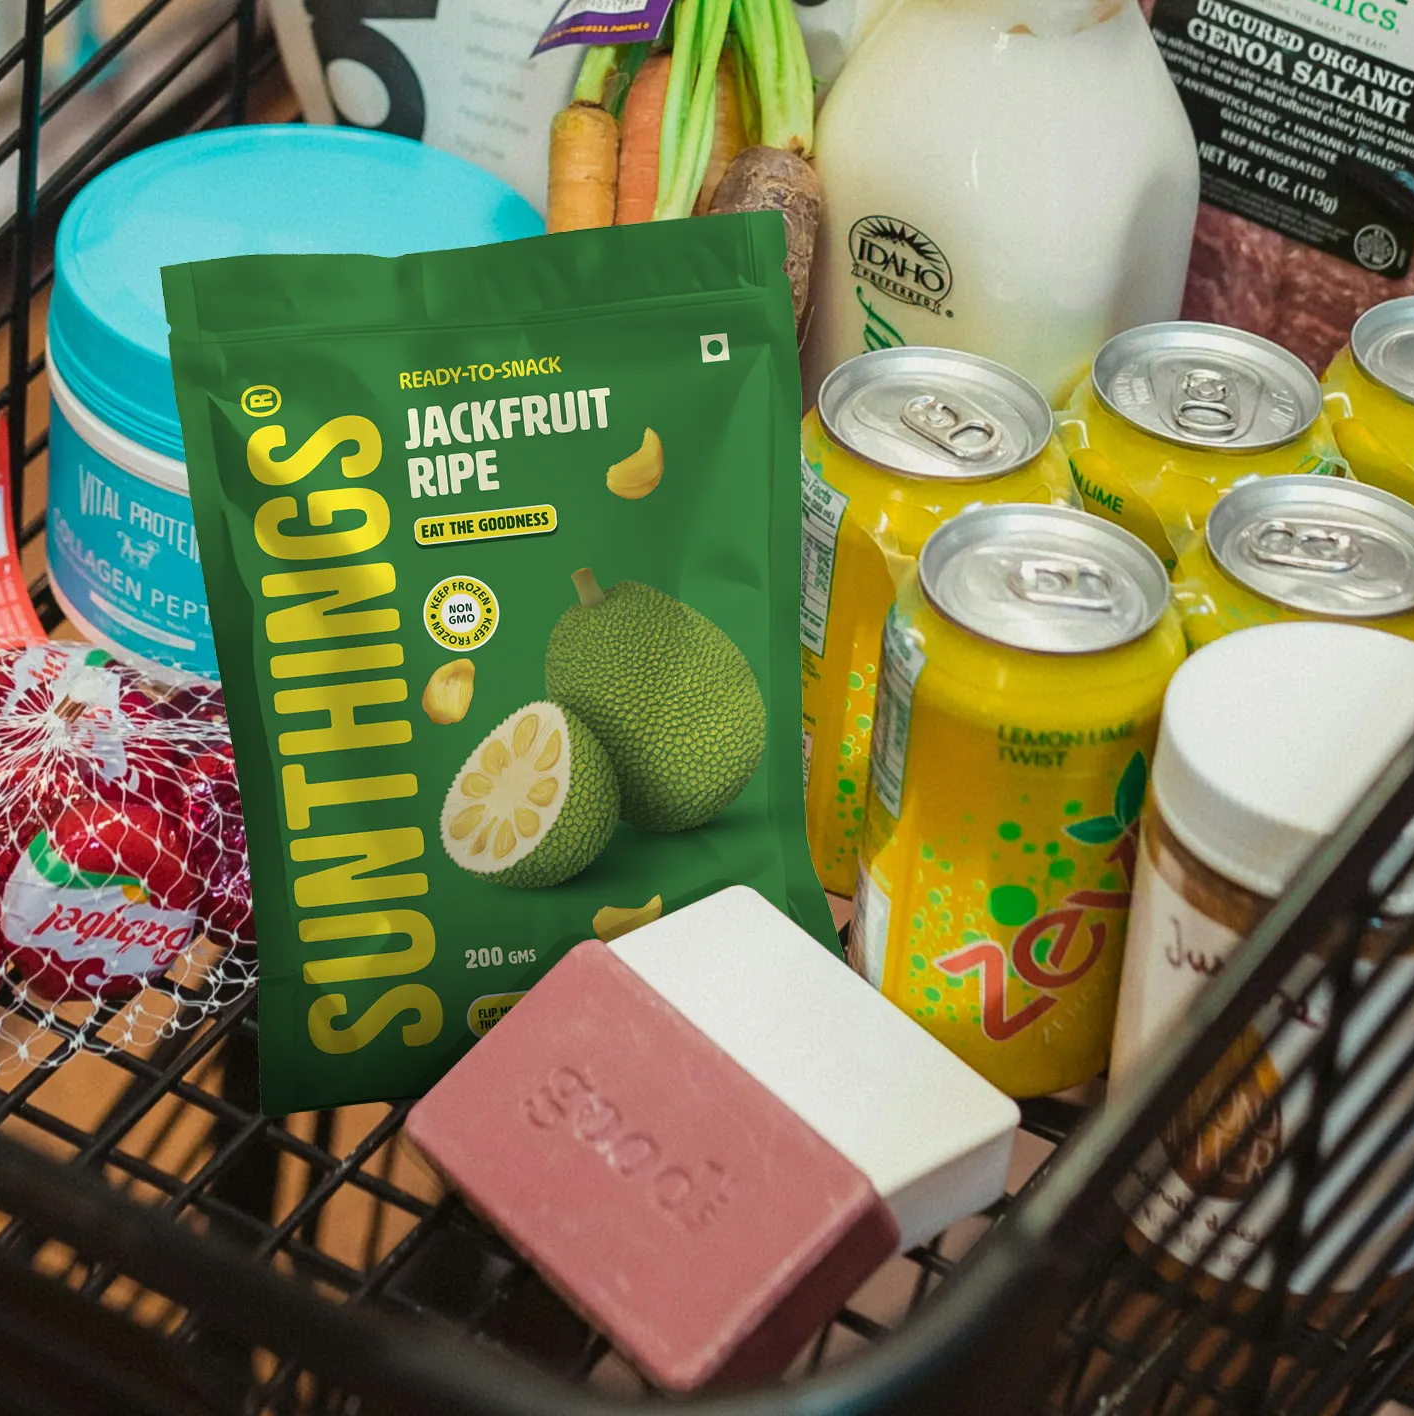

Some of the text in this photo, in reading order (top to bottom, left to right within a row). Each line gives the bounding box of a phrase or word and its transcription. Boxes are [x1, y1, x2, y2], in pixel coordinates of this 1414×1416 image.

[1165, 35, 1207, 60] nitrites
[1205, 53, 1219, 65] or
[1218, 56, 1263, 83] nitrates
[1261, 74, 1297, 97] added
[1295, 89, 1335, 114] except
[1333, 103, 1353, 120] for
[1352, 110, 1387, 133] those
[1183, 16, 1412, 124] GENOA SALAMI
[1181, 77, 1249, 113] ANTIBIOTICS
[1292, 122, 1355, 156] HUMANELY
[1199, 64, 1212, 76] in
[1211, 70, 1232, 85] sea
[1231, 77, 1254, 94] salt
[1254, 85, 1276, 103] and
[1274, 94, 1322, 122] cultured
[1320, 113, 1357, 137] celery
[1355, 127, 1385, 148] juice
[1218, 107, 1338, 164] GLUTEN & CASEIN FREE
[1219, 129, 1327, 181] KEEP REFRIGERATED
[1196, 142, 1340, 215] NET WT. 4 OZ. (113g)
[858, 237, 945, 292] IDAHO
[862, 268, 931, 309] PREFERRED
[399, 355, 562, 390] READY-TO-SNACK
[405, 387, 611, 450] JACKFRUIT
[78, 463, 122, 521] VITAL
[407, 449, 500, 499] RIPE
[1084, 476, 1125, 515] LIME
[421, 511, 550, 539] EAT THE GOODNESS
[52, 507, 142, 602] COLLAGEN
[430, 581, 492, 610] KEEP FROZEN
[448, 602, 473, 614] NON
[448, 614, 476, 625] GMO
[431, 617, 493, 646] KEEP FROZEN
[998, 721, 1134, 747] LEMON LIME
[999, 745, 1069, 768] TWIST
[31, 902, 189, 965] Babybel
[464, 946, 538, 969] 200 GMS
[478, 1007, 498, 1019] FLIP
